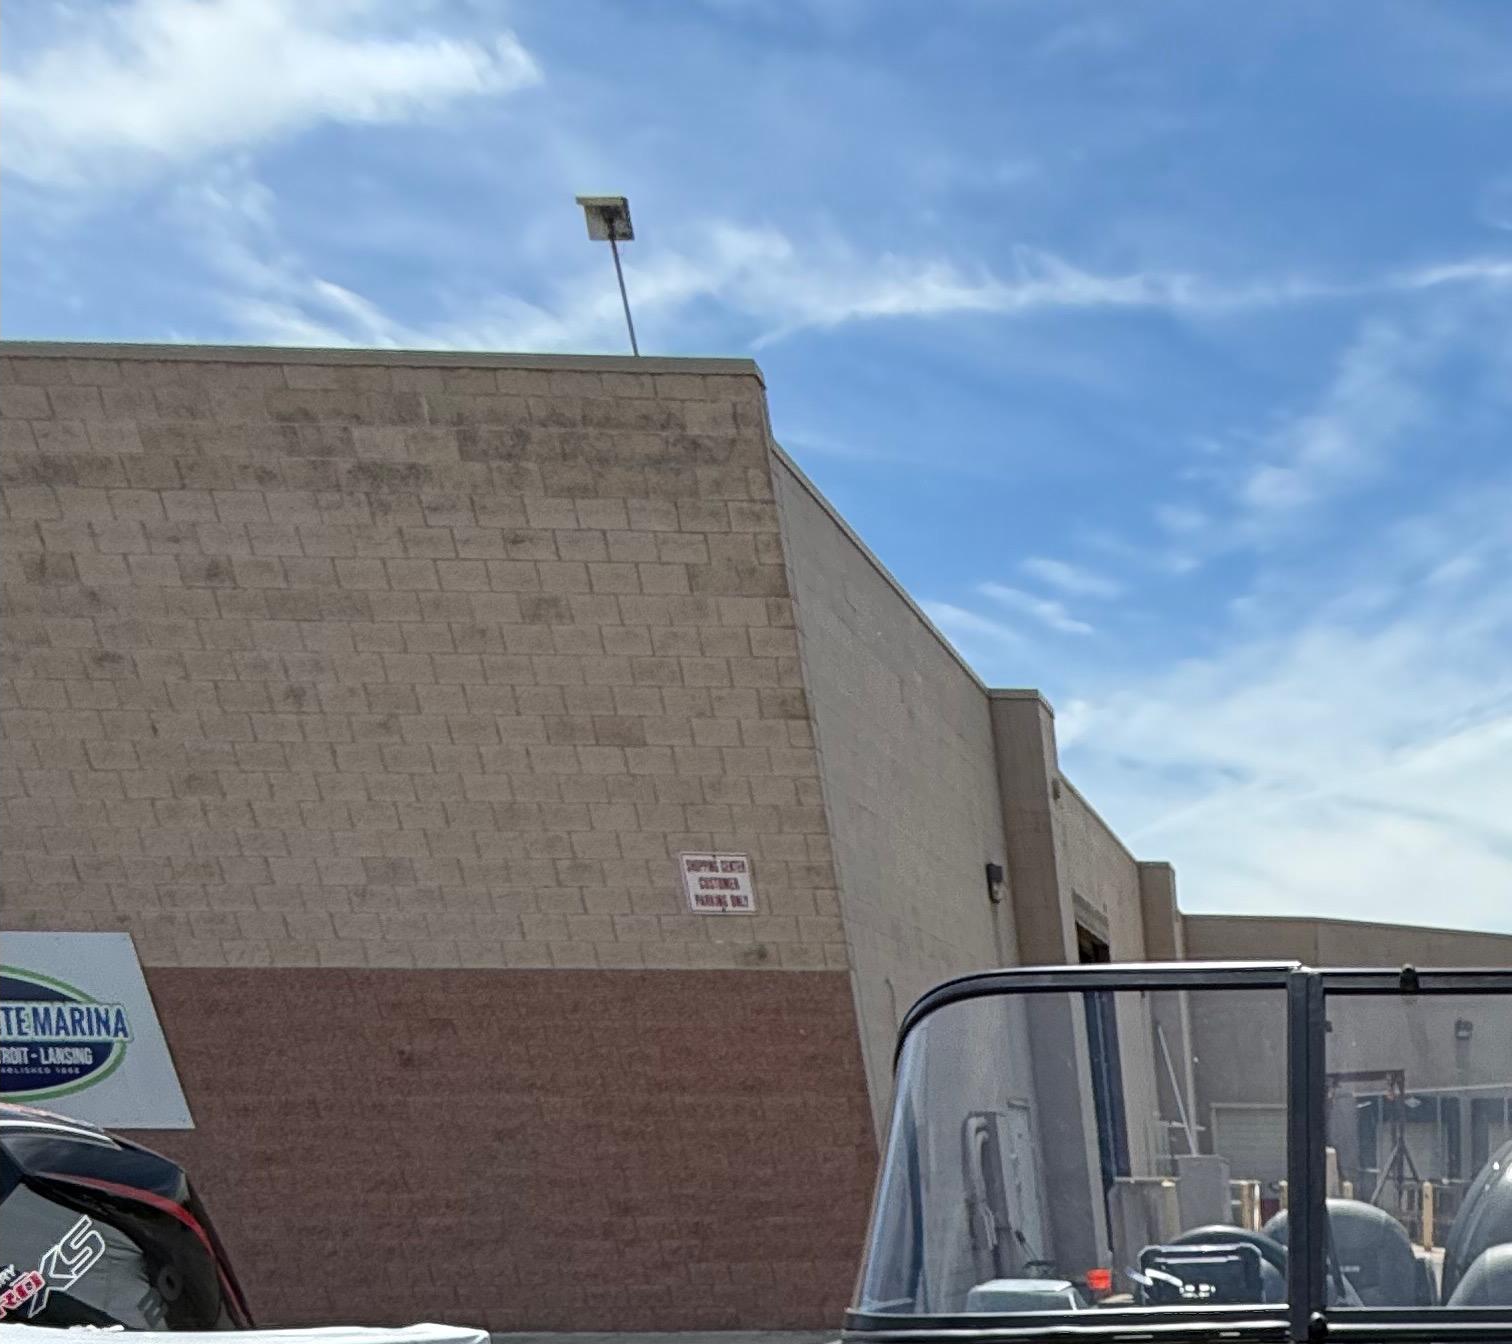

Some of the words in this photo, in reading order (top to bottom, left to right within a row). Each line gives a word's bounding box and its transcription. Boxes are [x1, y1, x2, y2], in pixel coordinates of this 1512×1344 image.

[0, 1006, 29, 1036] TE
[32, 1006, 129, 1038] MARINA
[39, 1046, 93, 1065] LANSING
[28, 1214, 106, 1318] XS
